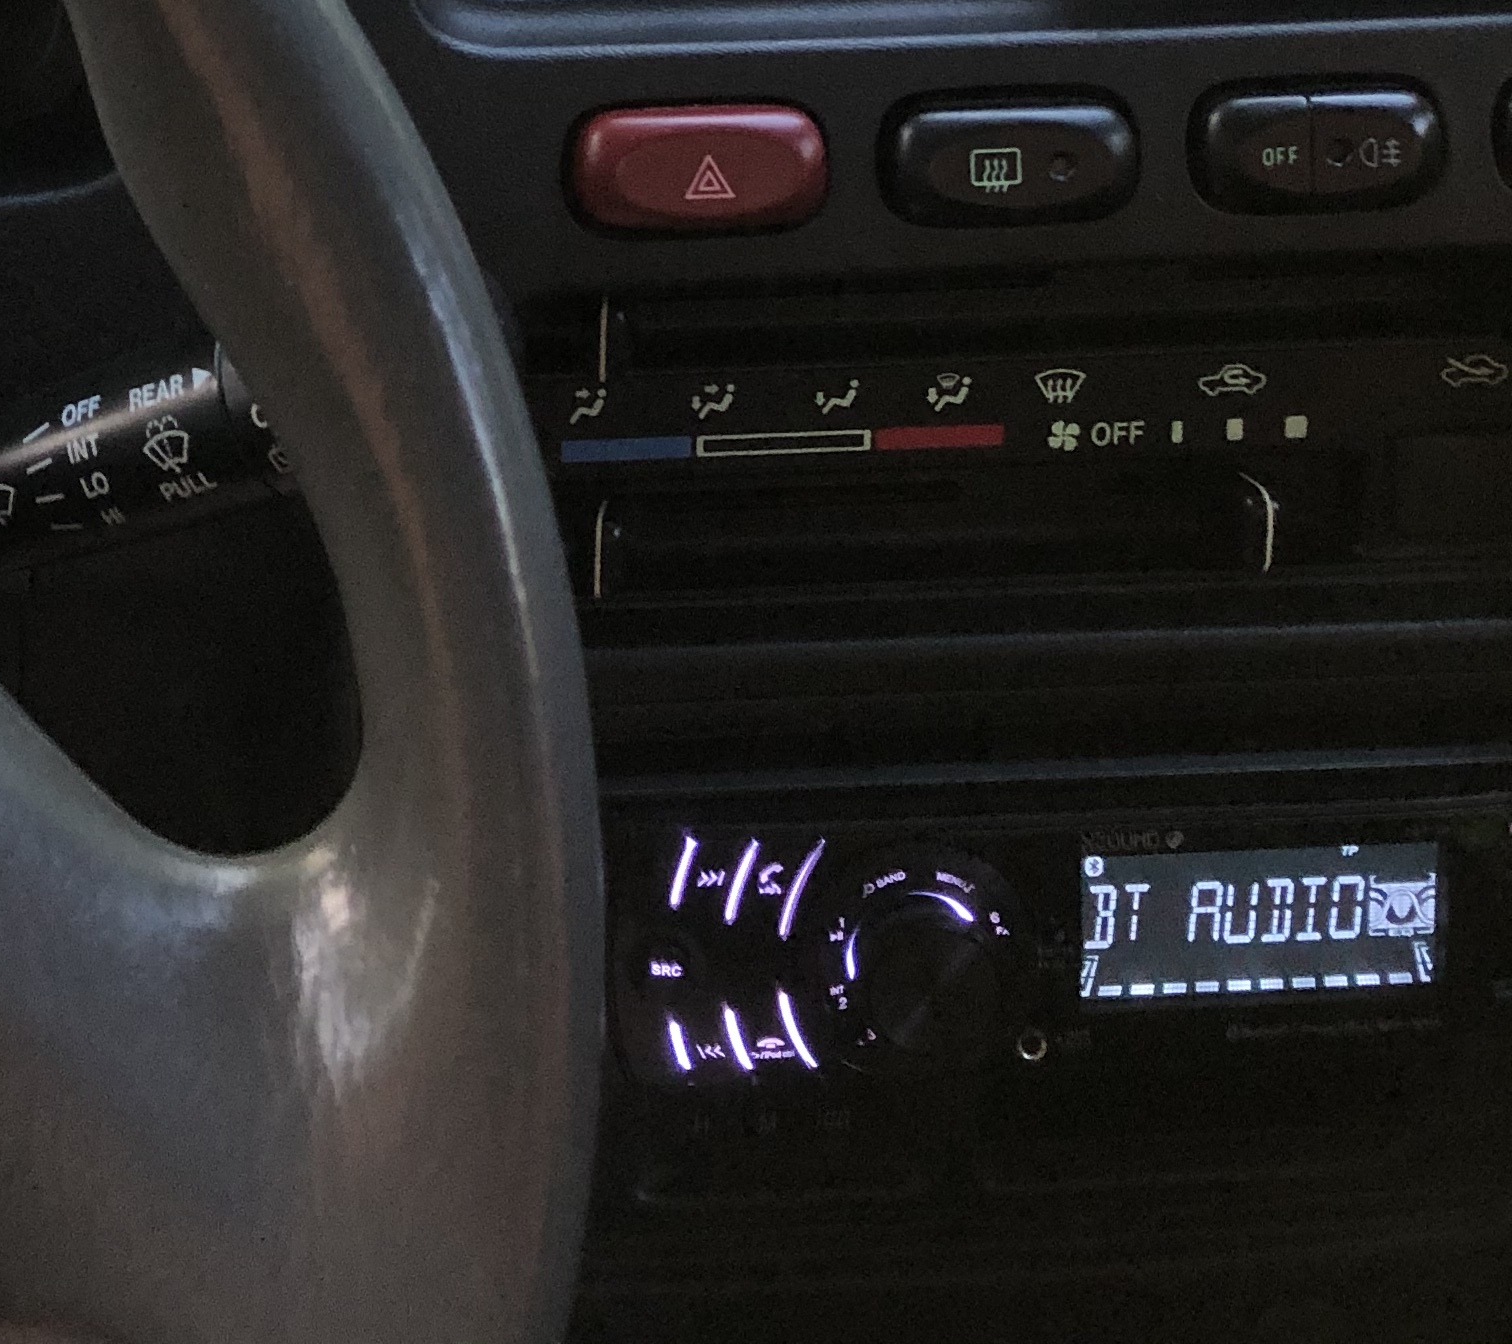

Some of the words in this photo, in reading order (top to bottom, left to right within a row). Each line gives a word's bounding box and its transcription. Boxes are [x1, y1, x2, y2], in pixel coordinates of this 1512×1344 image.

[1262, 145, 1298, 167] OFF
[129, 373, 183, 412] REAR
[60, 394, 102, 427] OFF
[1090, 420, 1145, 447] OFF
[67, 432, 100, 464] INT
[79, 471, 110, 499] LO
[159, 471, 218, 501] PULL
[1341, 844, 1360, 857] TP
[875, 869, 907, 889] BAND
[1083, 883, 1151, 950] BT
[1187, 874, 1366, 945] AUDIO
[649, 960, 684, 978] SRC
[838, 996, 848, 1010] 2
